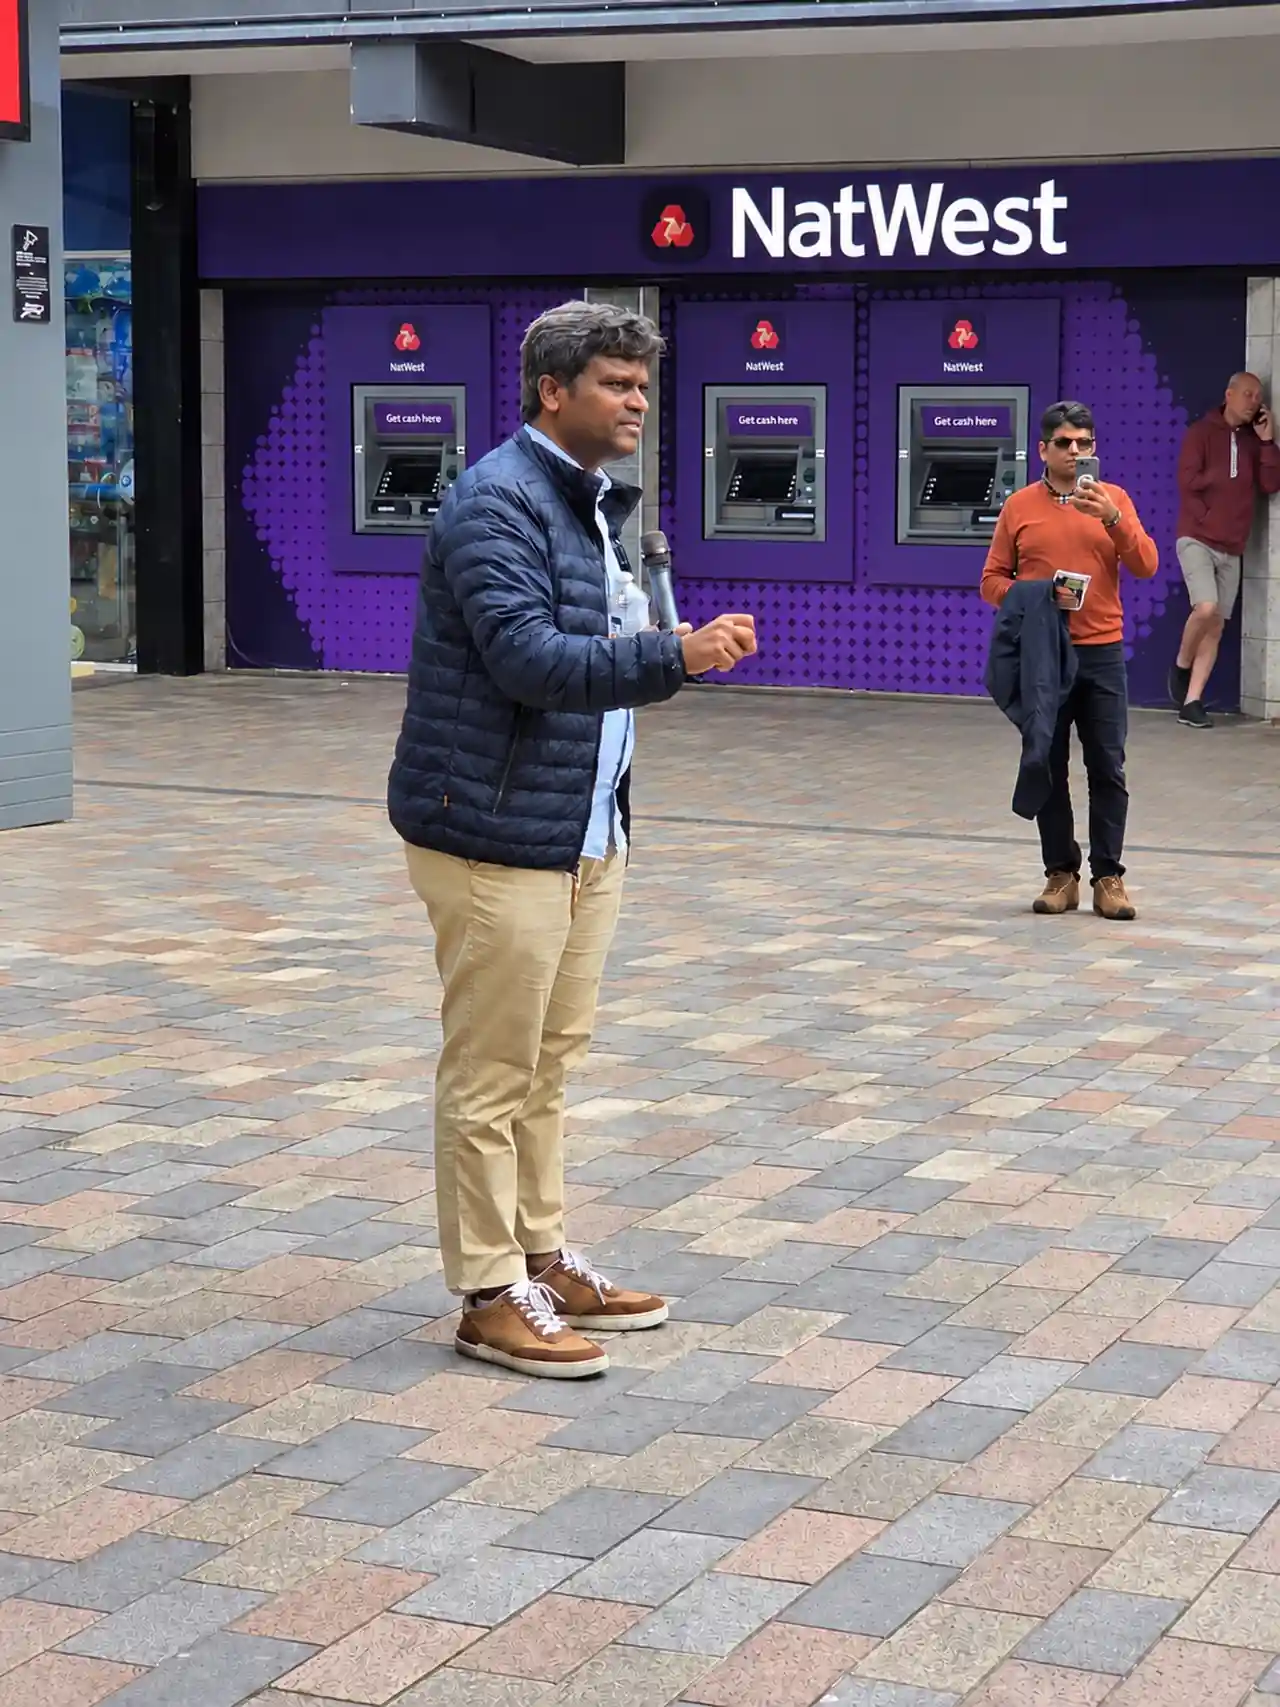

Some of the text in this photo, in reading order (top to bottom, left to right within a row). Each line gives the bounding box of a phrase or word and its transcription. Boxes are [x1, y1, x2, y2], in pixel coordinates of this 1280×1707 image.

[731, 179, 1068, 258] NatWest
[389, 362, 425, 372] NatWest
[745, 361, 784, 372] NatWest
[943, 361, 984, 373] NatWest
[386, 413, 442, 423] Get cash here
[738, 415, 798, 425] Get cash here
[934, 416, 998, 426] Get cash here
